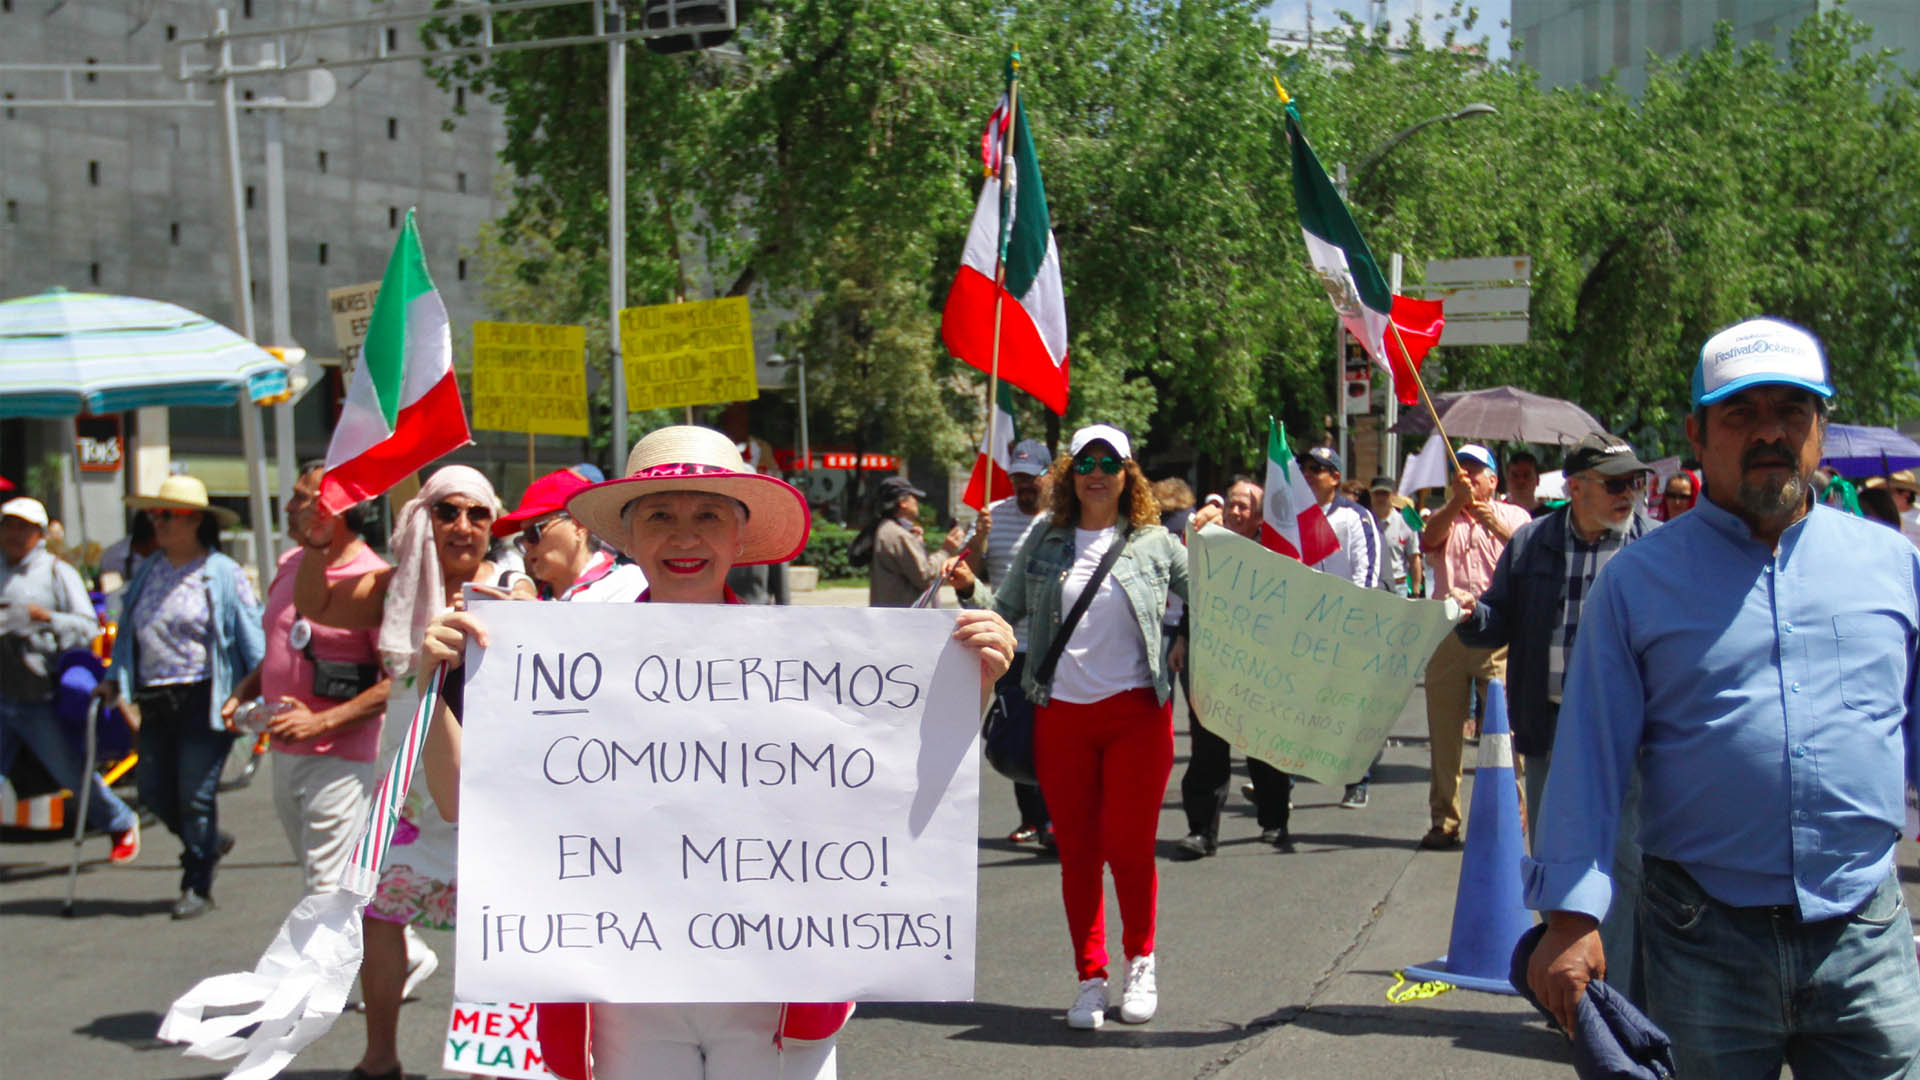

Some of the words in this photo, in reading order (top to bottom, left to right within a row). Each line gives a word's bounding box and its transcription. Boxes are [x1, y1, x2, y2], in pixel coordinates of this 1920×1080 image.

[1205, 546, 1287, 615] VIVA
[513, 645, 602, 704] ¡NO
[634, 654, 920, 709] QUEREMOS
[1290, 631, 1345, 668] DEL
[542, 735, 875, 789] COMUNISMO
[558, 834, 622, 881] EN
[682, 834, 889, 888] MEXICO!
[481, 905, 662, 961] ¡FUERA
[688, 912, 953, 961] COMUNISTAS!
